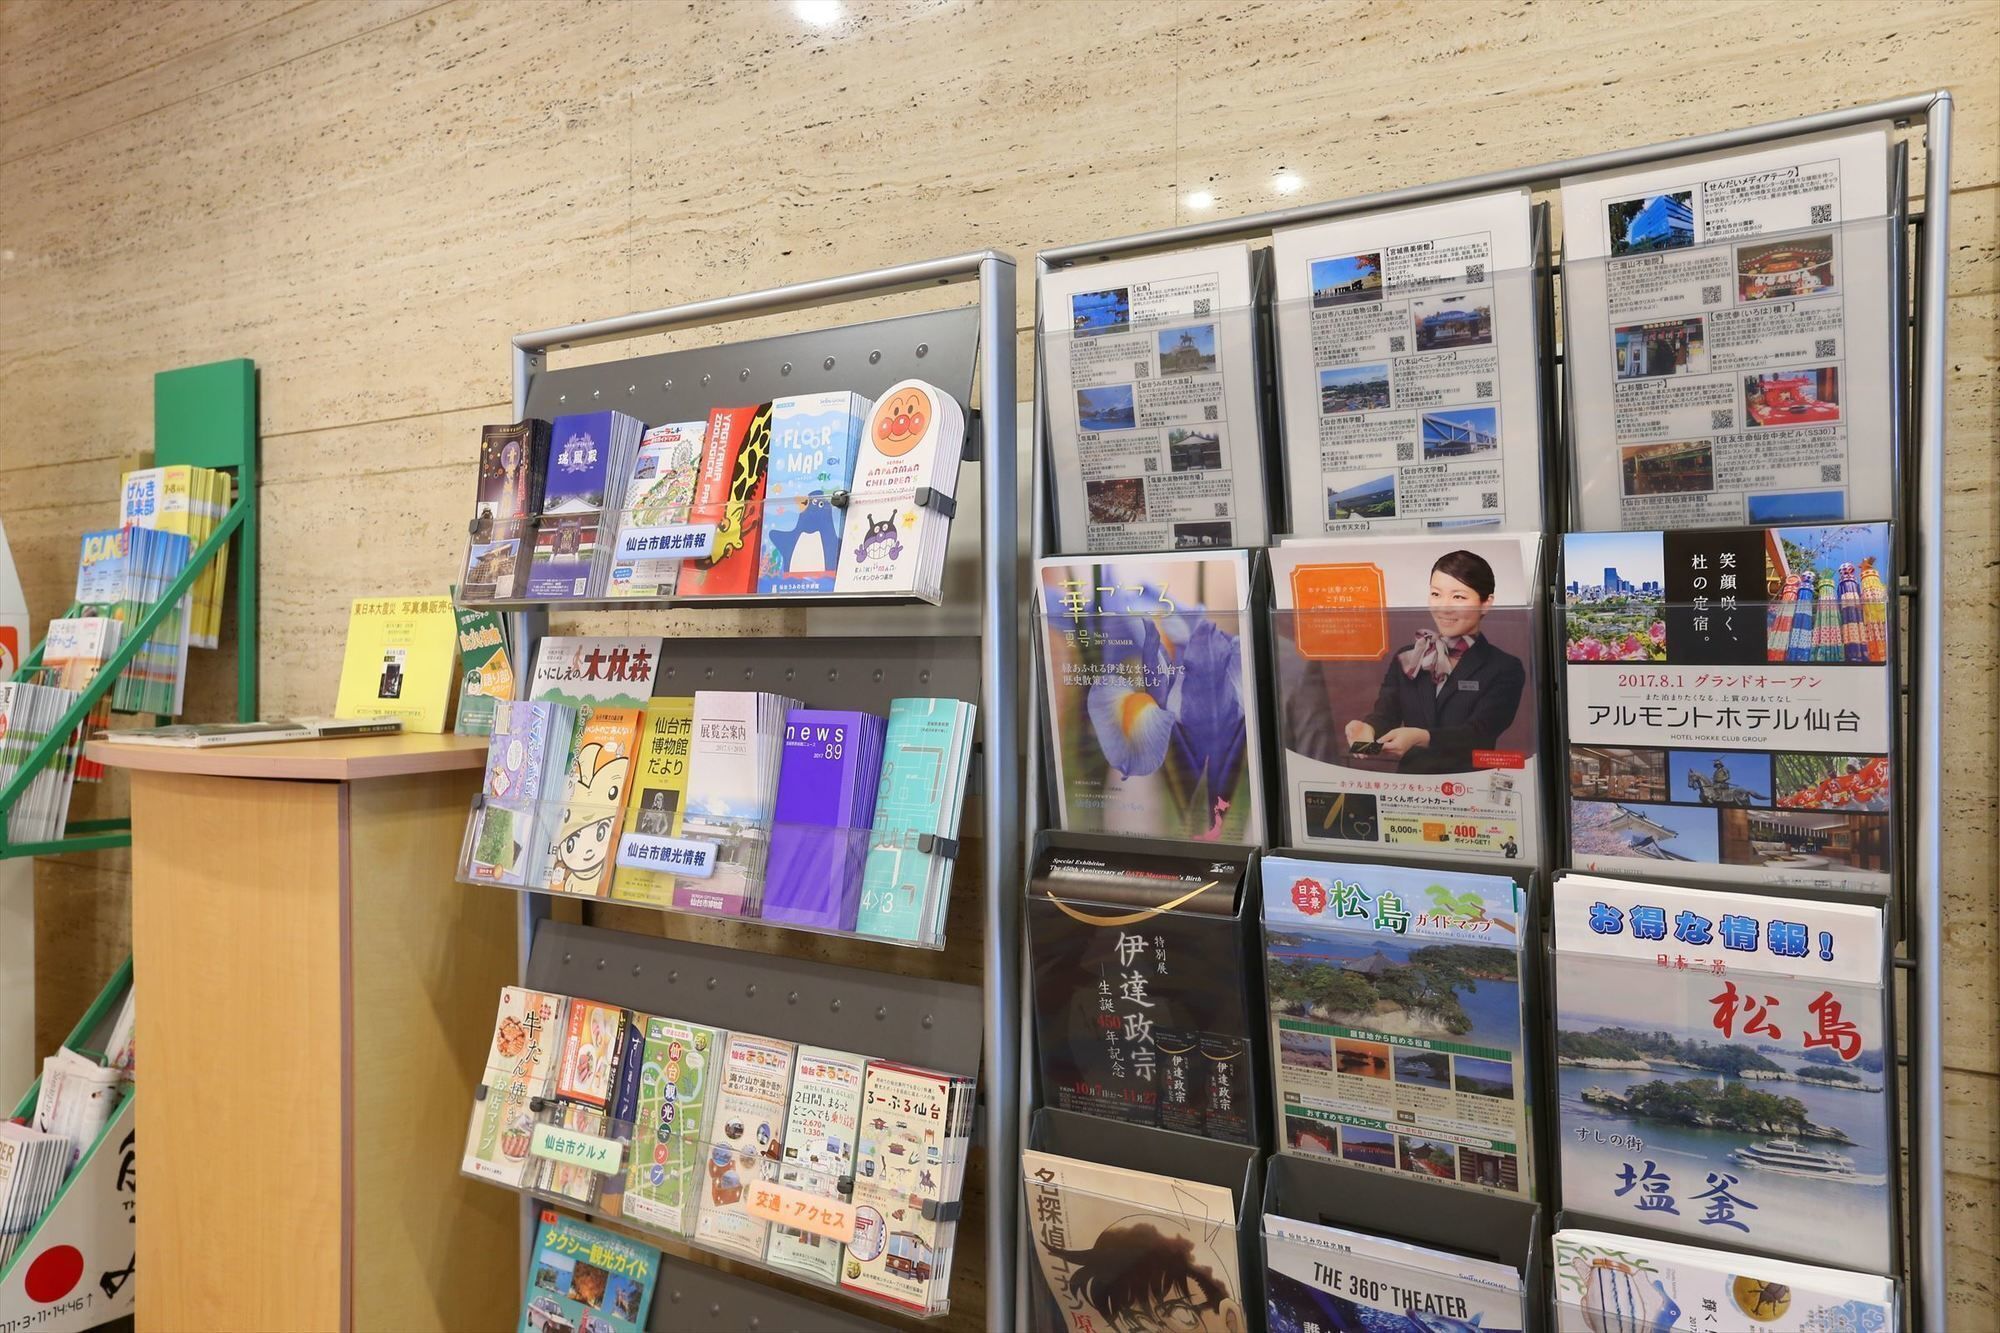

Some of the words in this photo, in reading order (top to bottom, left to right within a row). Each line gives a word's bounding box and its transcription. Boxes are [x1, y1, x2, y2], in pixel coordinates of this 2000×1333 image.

[706, 413, 723, 481] ZOOLOGICAL
[715, 413, 732, 483] YAGIYAMA
[784, 426, 832, 449] FLOOR
[788, 450, 823, 474] MAP
[868, 464, 919, 476] ANPANMAN
[127, 480, 155, 499] げんき
[695, 484, 712, 514] PARK
[626, 533, 706, 551] 仙台市観光情報
[1058, 579, 1176, 623] 華ごころ
[1691, 554, 1709, 642] 杜の定宿。
[1719, 552, 1738, 641] 笑顔咲く、
[1064, 629, 1090, 648] 夏号
[1618, 674, 1684, 689] 2017.8.1
[1694, 674, 1822, 689] グランドオープン
[1645, 693, 1792, 704] また泊まりたくなる、上質のおもてなし
[655, 717, 692, 735] 仙台市
[1587, 705, 1861, 733] アルモントホテル仙台
[701, 725, 747, 741] 展覧会案内
[786, 726, 844, 742] news
[651, 737, 687, 755] 博物館
[825, 744, 842, 759] 89
[647, 759, 683, 776] だより
[1380, 794, 1456, 806] ほっくんポイントカード
[1390, 825, 1417, 834] 8,000円
[1454, 825, 1477, 838] 400
[627, 842, 706, 866] 仙台市観光情報
[1075, 859, 1105, 867] Exhibition
[1081, 867, 1115, 877] Anniversary
[1117, 869, 1125, 877] of
[1299, 885, 1320, 896] 日本
[1299, 897, 1321, 909] 三景
[1329, 879, 1412, 934] 松島
[1416, 914, 1494, 933] ガイドマップ
[1589, 901, 1834, 960] お得な情報!
[1154, 935, 1168, 975] 特別展
[1114, 931, 1157, 1082] 伊達政宗
[1097, 979, 1125, 1079] 生誕450年記念
[1709, 981, 1862, 1061] 松島
[1350, 1029, 1431, 1049] 展望地から眺める松島
[506, 1010, 541, 1125] 牛たん焼き
[1172, 1055, 1186, 1103] 伊達政宗
[1217, 1062, 1231, 1110] 伊達政宗
[652, 1043, 681, 1182] 仙台観光マップ
[795, 1091, 848, 1112] 2日間、まるっと
[481, 1077, 507, 1151] お店マップ
[793, 1105, 855, 1130] どこへでも乗り放題
[1306, 1109, 1382, 1129] おすすめモデルコース
[545, 1135, 609, 1160] 仙台市グルメ
[1576, 1127, 1644, 1151] すしの街
[1614, 1160, 1759, 1233] 塩釜
[755, 1190, 846, 1228] 交通・アクセス
[545, 1229, 649, 1279] タクシー観光ガイド
[1314, 1262, 1342, 1290] THE
[1349, 1275, 1388, 1301] 360°
[1391, 1286, 1468, 1318] THEATER
